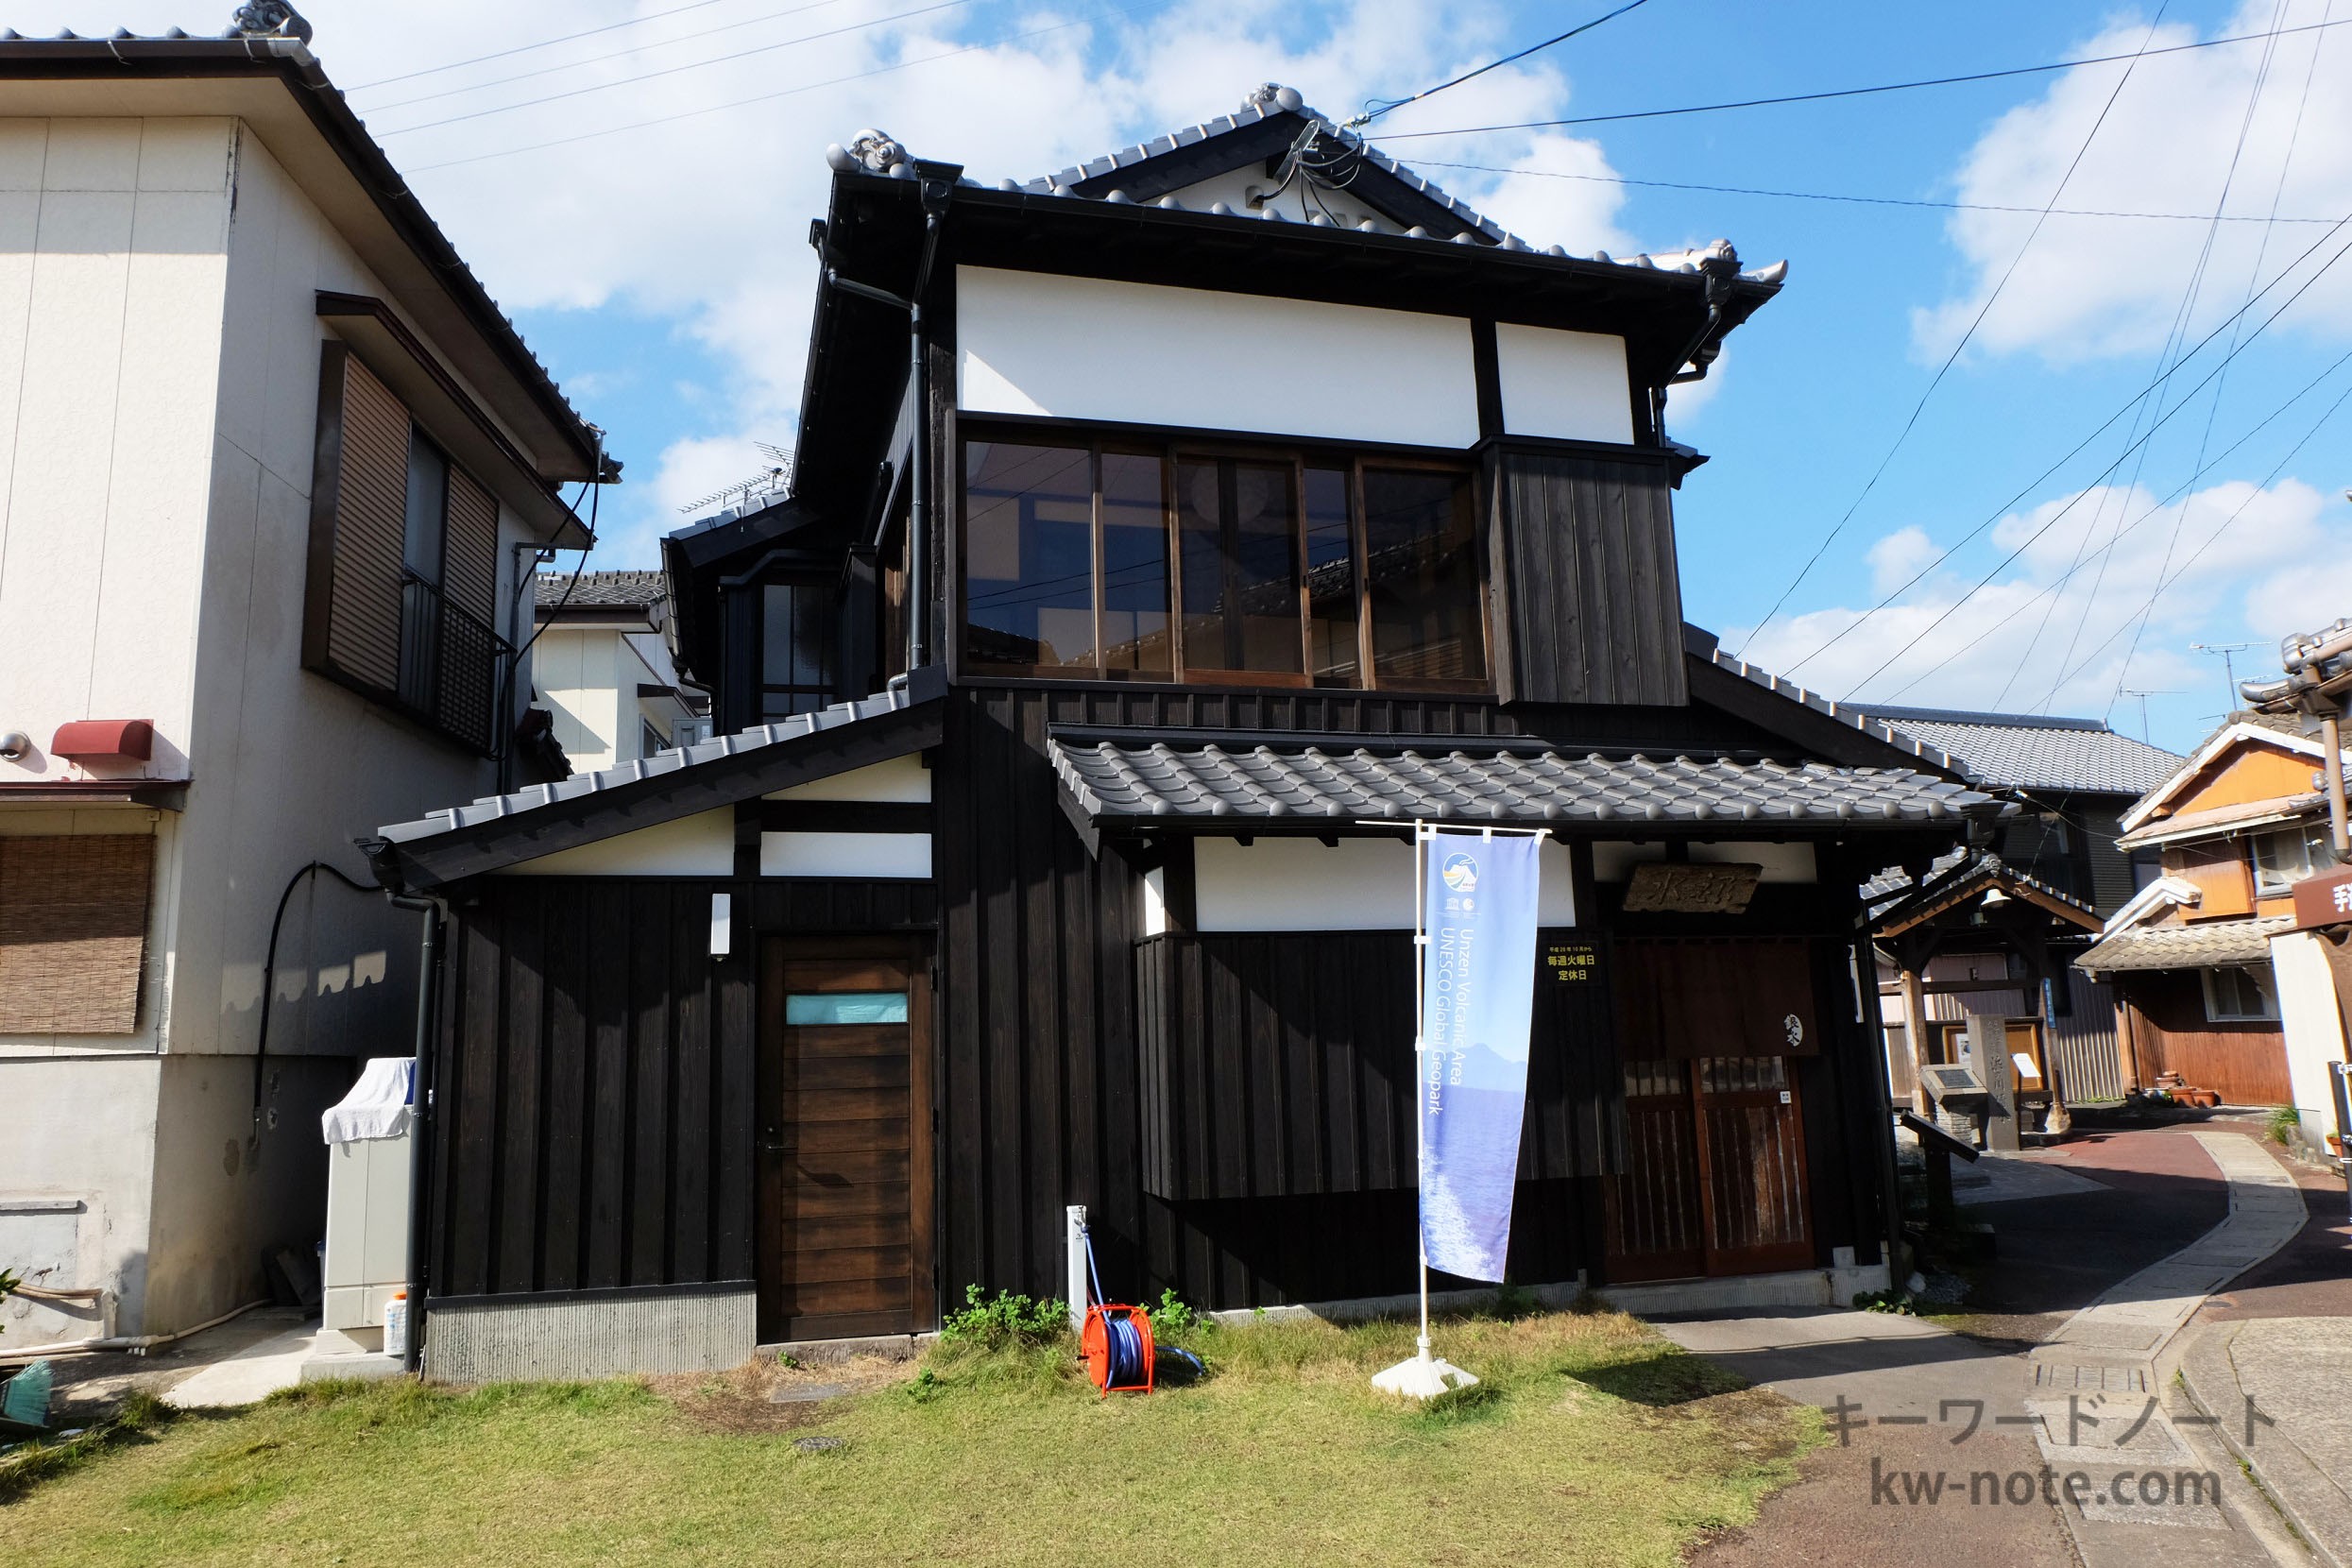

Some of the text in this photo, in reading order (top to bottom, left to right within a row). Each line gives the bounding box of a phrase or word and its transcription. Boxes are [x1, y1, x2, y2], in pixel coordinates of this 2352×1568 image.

[2333, 883, 2352, 912] 手
[1458, 929, 1474, 977] Unzen
[1547, 955, 1595, 966] 毎週火曜日
[1558, 969, 1587, 981] 定休日
[1429, 928, 1456, 1115] UNESCO Global Geopark
[1454, 981, 1472, 1047] Volcanic
[1450, 1050, 1467, 1085] Area
